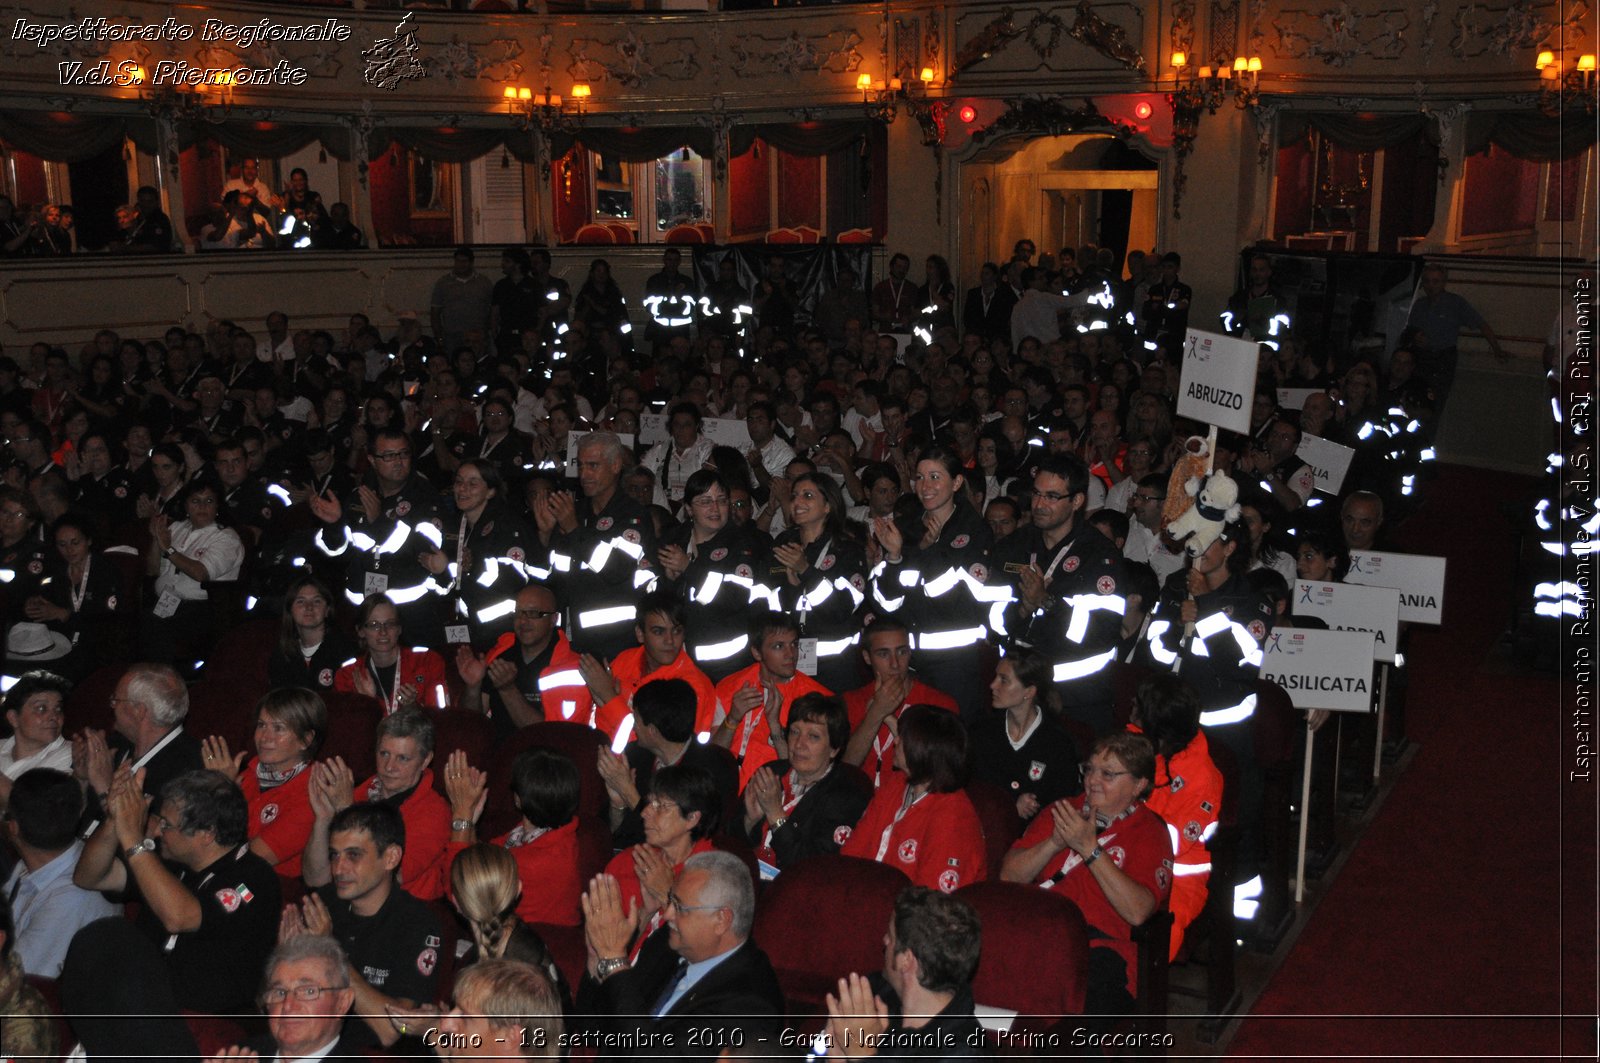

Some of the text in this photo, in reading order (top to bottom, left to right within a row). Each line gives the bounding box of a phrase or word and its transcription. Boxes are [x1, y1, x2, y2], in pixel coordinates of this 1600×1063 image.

[1187, 381, 1243, 410] ABRUZZO
[1312, 466, 1329, 480] LIA
[1399, 593, 1437, 608] ANIA
